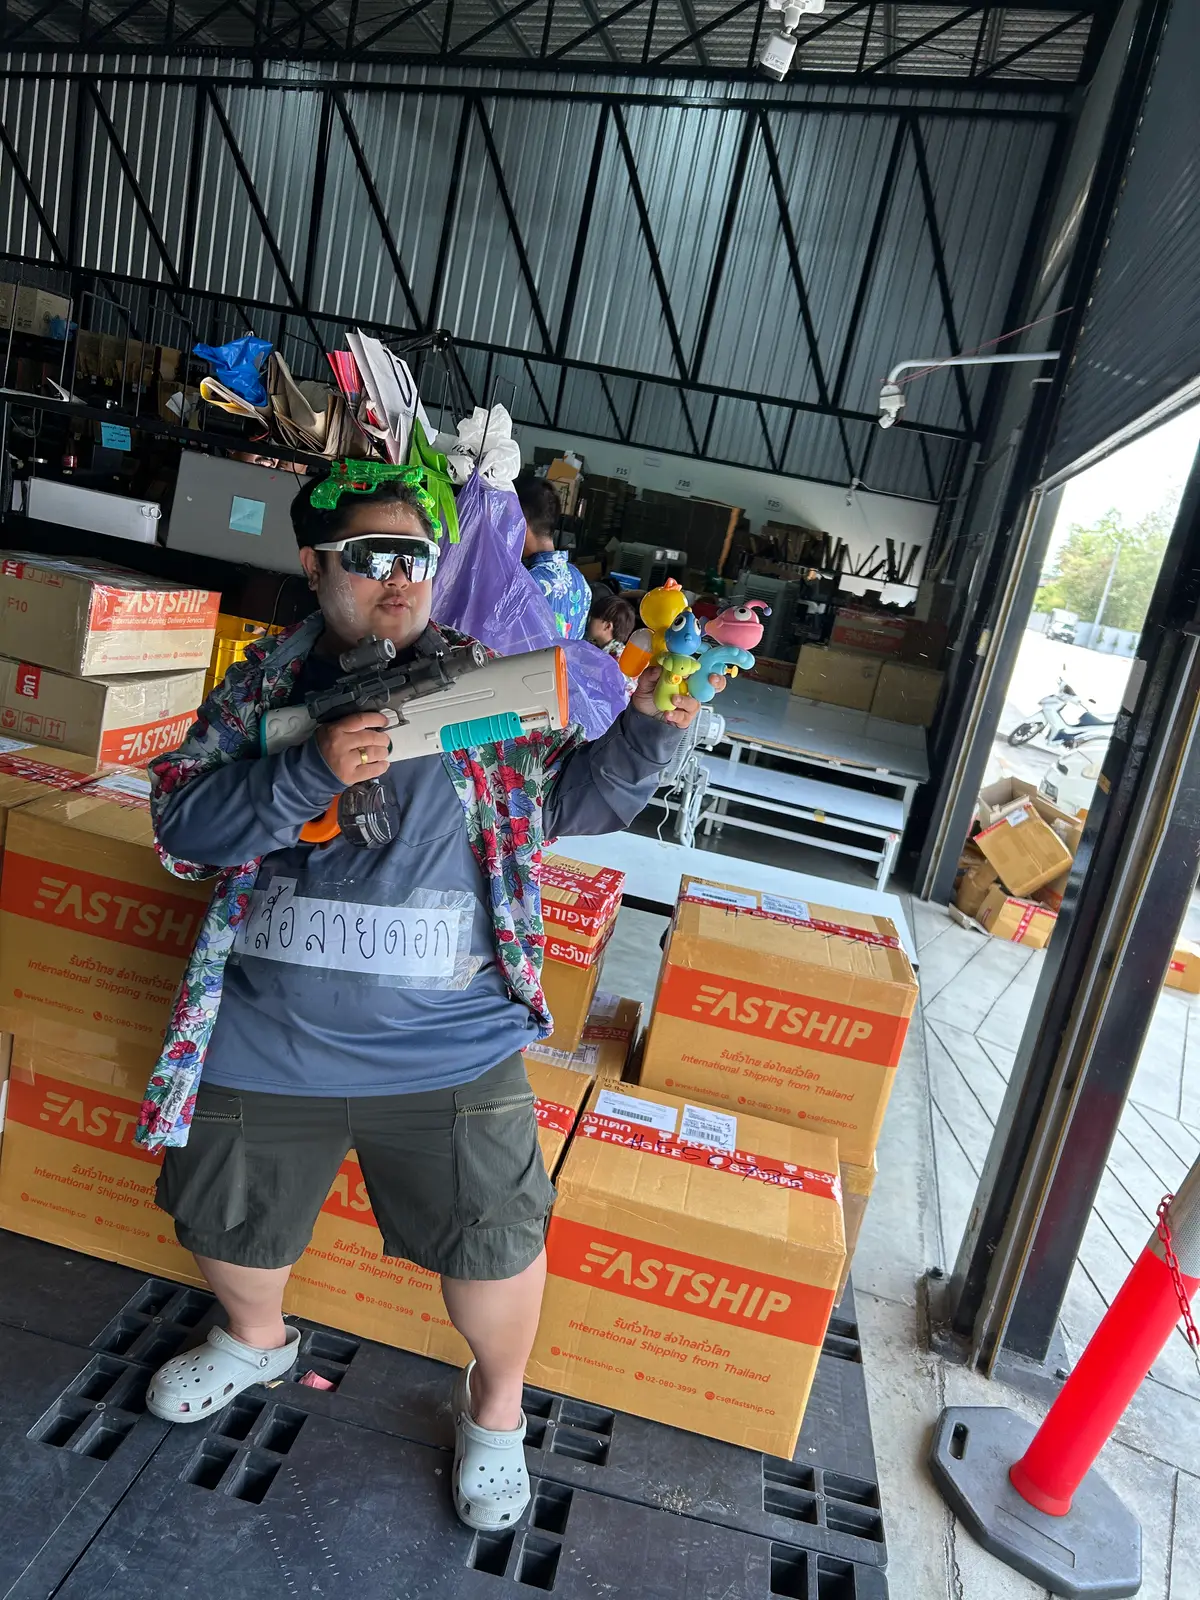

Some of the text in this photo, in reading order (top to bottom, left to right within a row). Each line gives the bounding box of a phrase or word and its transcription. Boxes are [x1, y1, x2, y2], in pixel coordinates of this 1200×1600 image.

[615, 467, 628, 476] F15
[678, 479, 691, 488] F20
[8, 597, 28, 613] F10
[543, 905, 603, 929] RAGILE
[69, 954, 115, 976] รับทั่วไทย
[28, 960, 170, 1005] International Shipping from
[24, 991, 84, 1014] www.fastship.co
[691, 984, 873, 1049] FASTSHIP
[719, 1049, 762, 1069] รับทั่วไทย
[681, 1053, 855, 1102] International Shipping from Thailand
[674, 1081, 730, 1101] www.fastship.co
[601, 1131, 682, 1159] FRAGILE
[72, 1164, 114, 1185] รับทั่วไทย
[34, 1167, 93, 1192] International
[96, 1186, 139, 1207] Shipping
[30, 1197, 87, 1220] www.fastship.co
[333, 1238, 378, 1262] รับทั่วไทย
[305, 1246, 433, 1292] ernational Shipping from
[580, 1241, 791, 1322] FASTSHIP
[365, 1296, 414, 1317] 02-080-3999
[613, 1316, 731, 1358] รับทั่วไทย ส่งไกลทั่วโลก
[561, 1350, 625, 1375] www.fastship.co
[568, 1319, 771, 1384] International Shipping from Thailand
[645, 1375, 697, 1395] 02-080-3999
[716, 1394, 776, 1416] cs@fastship.co
